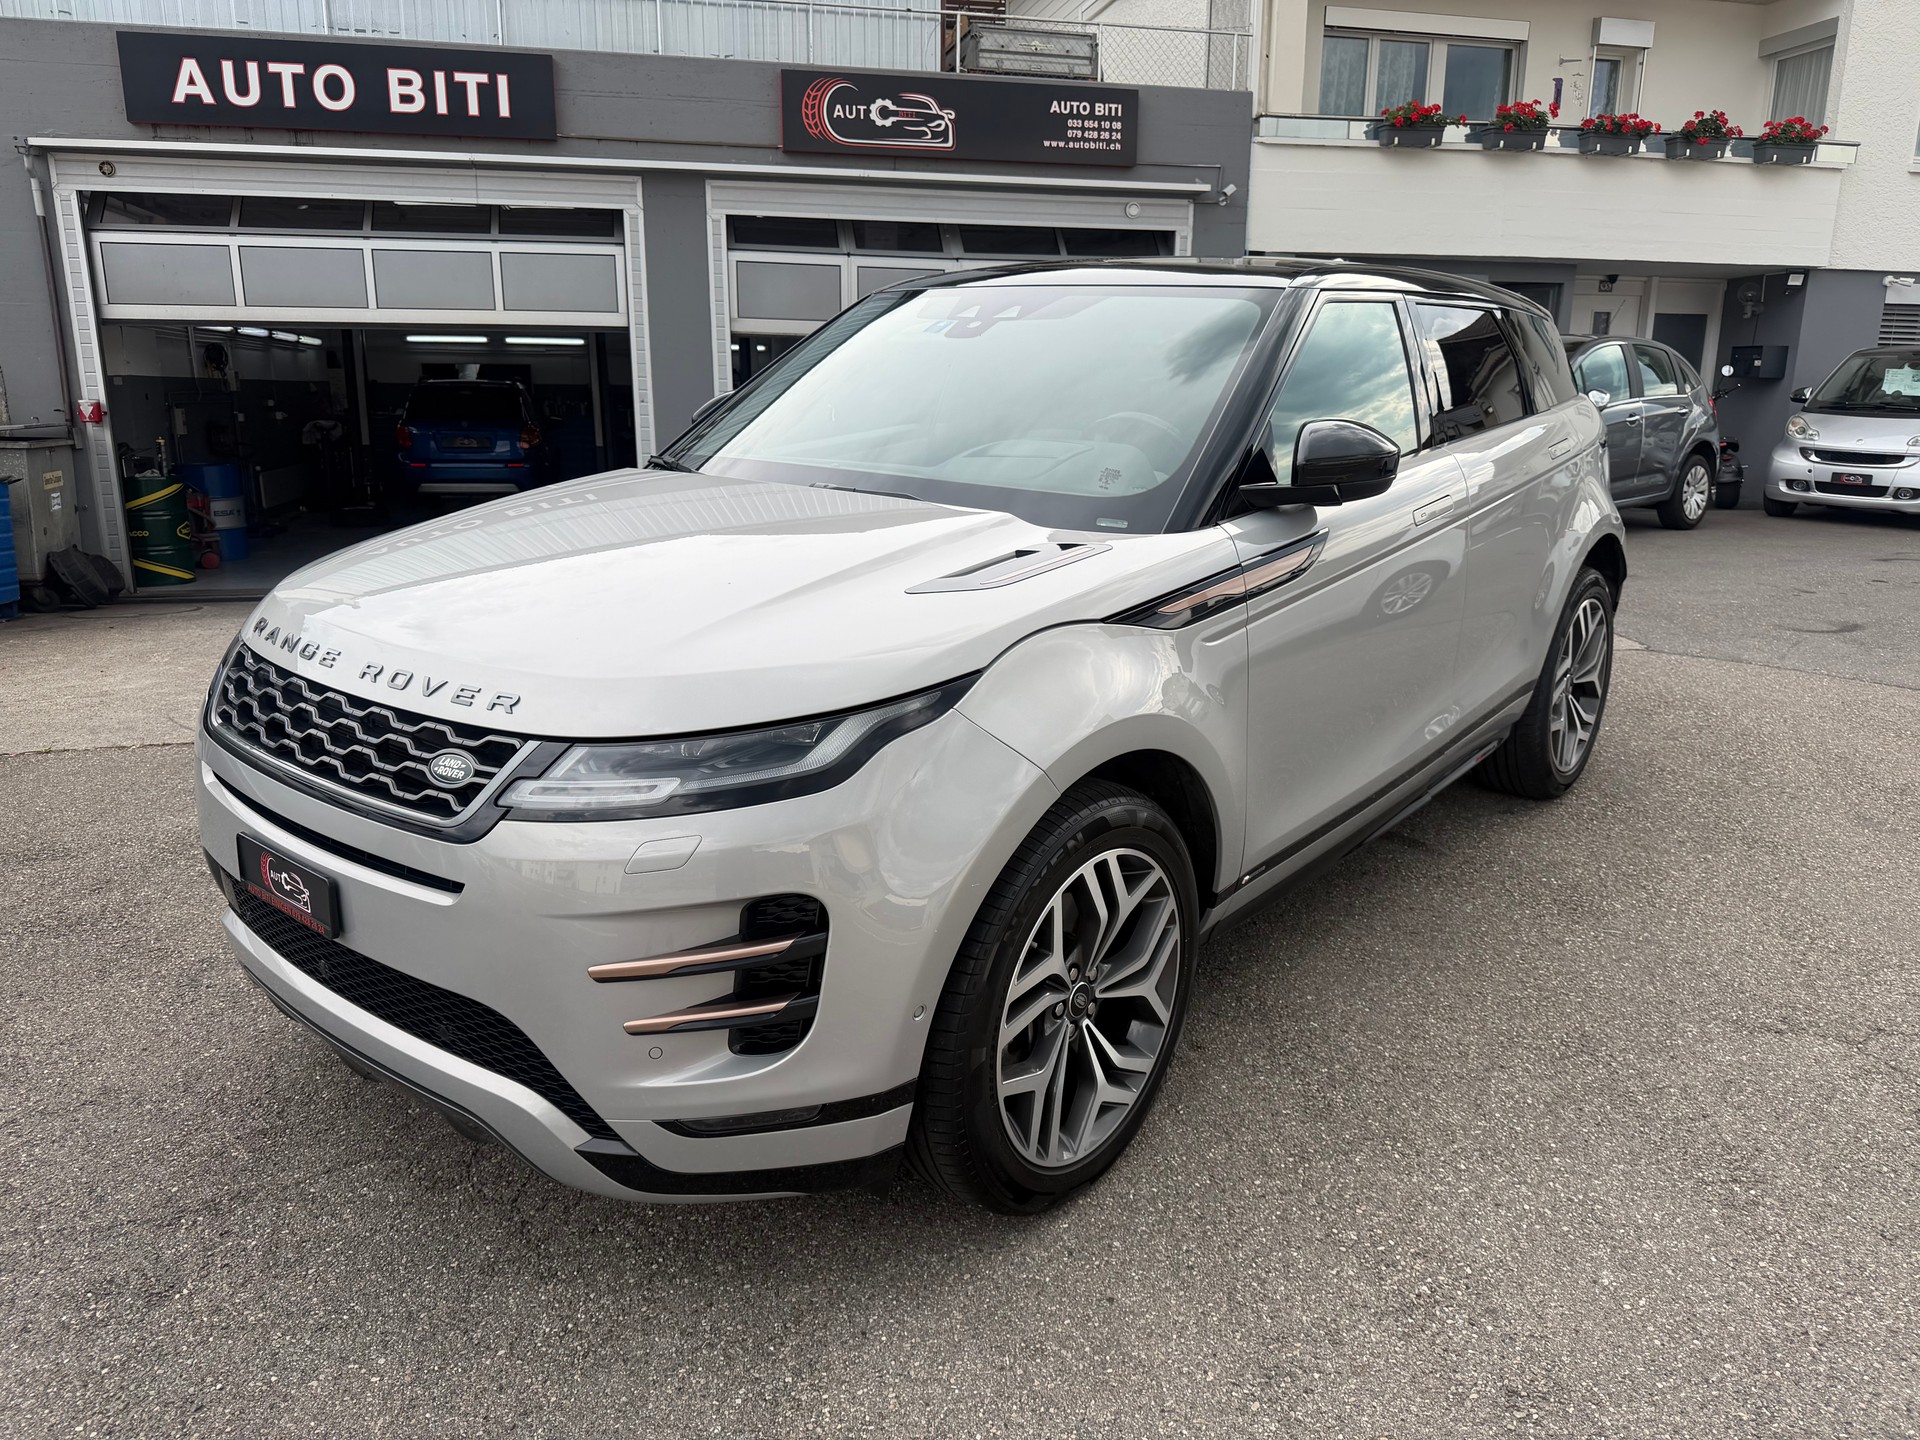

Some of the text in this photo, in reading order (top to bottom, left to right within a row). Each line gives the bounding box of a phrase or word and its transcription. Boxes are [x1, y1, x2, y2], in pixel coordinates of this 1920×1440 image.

[171, 57, 511, 118] AUTO BITI
[1050, 100, 1122, 117] AUTO BITI
[1067, 119, 1122, 130] 033 654 10 08
[1067, 129, 1122, 140] 079 428 26 24
[1043, 139, 1122, 151] www.autobiti.ch
[252, 616, 521, 715] RANGE ROVER
[438, 756, 462, 769] LAND
[436, 765, 465, 780] ROVER
